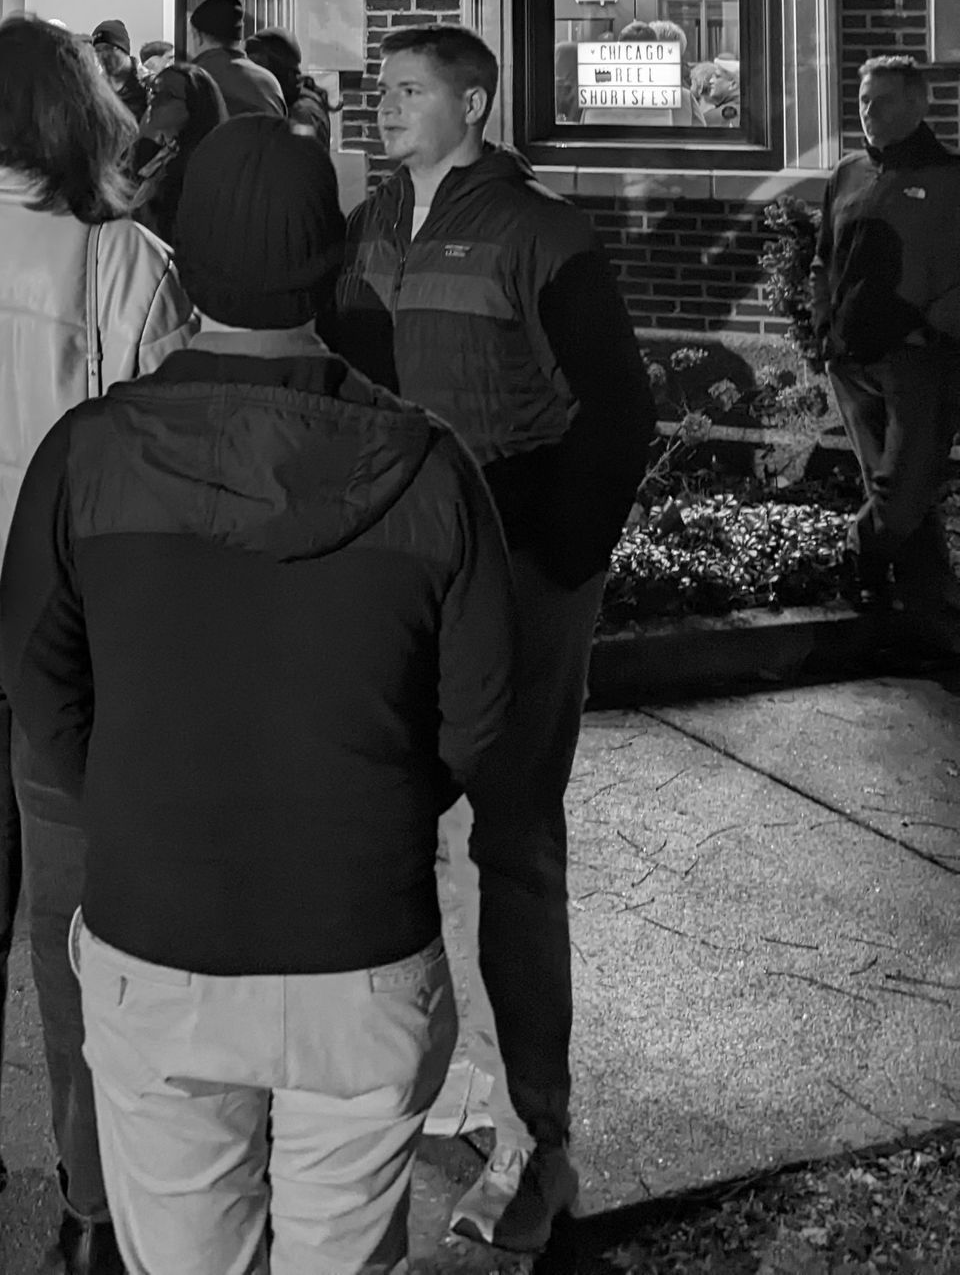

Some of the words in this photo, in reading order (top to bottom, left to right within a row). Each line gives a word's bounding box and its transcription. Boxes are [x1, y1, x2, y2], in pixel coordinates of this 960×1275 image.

[600, 44, 664, 61] CHICAGO
[615, 67, 655, 83] REEL
[580, 88, 677, 106] SHORTSFEST
